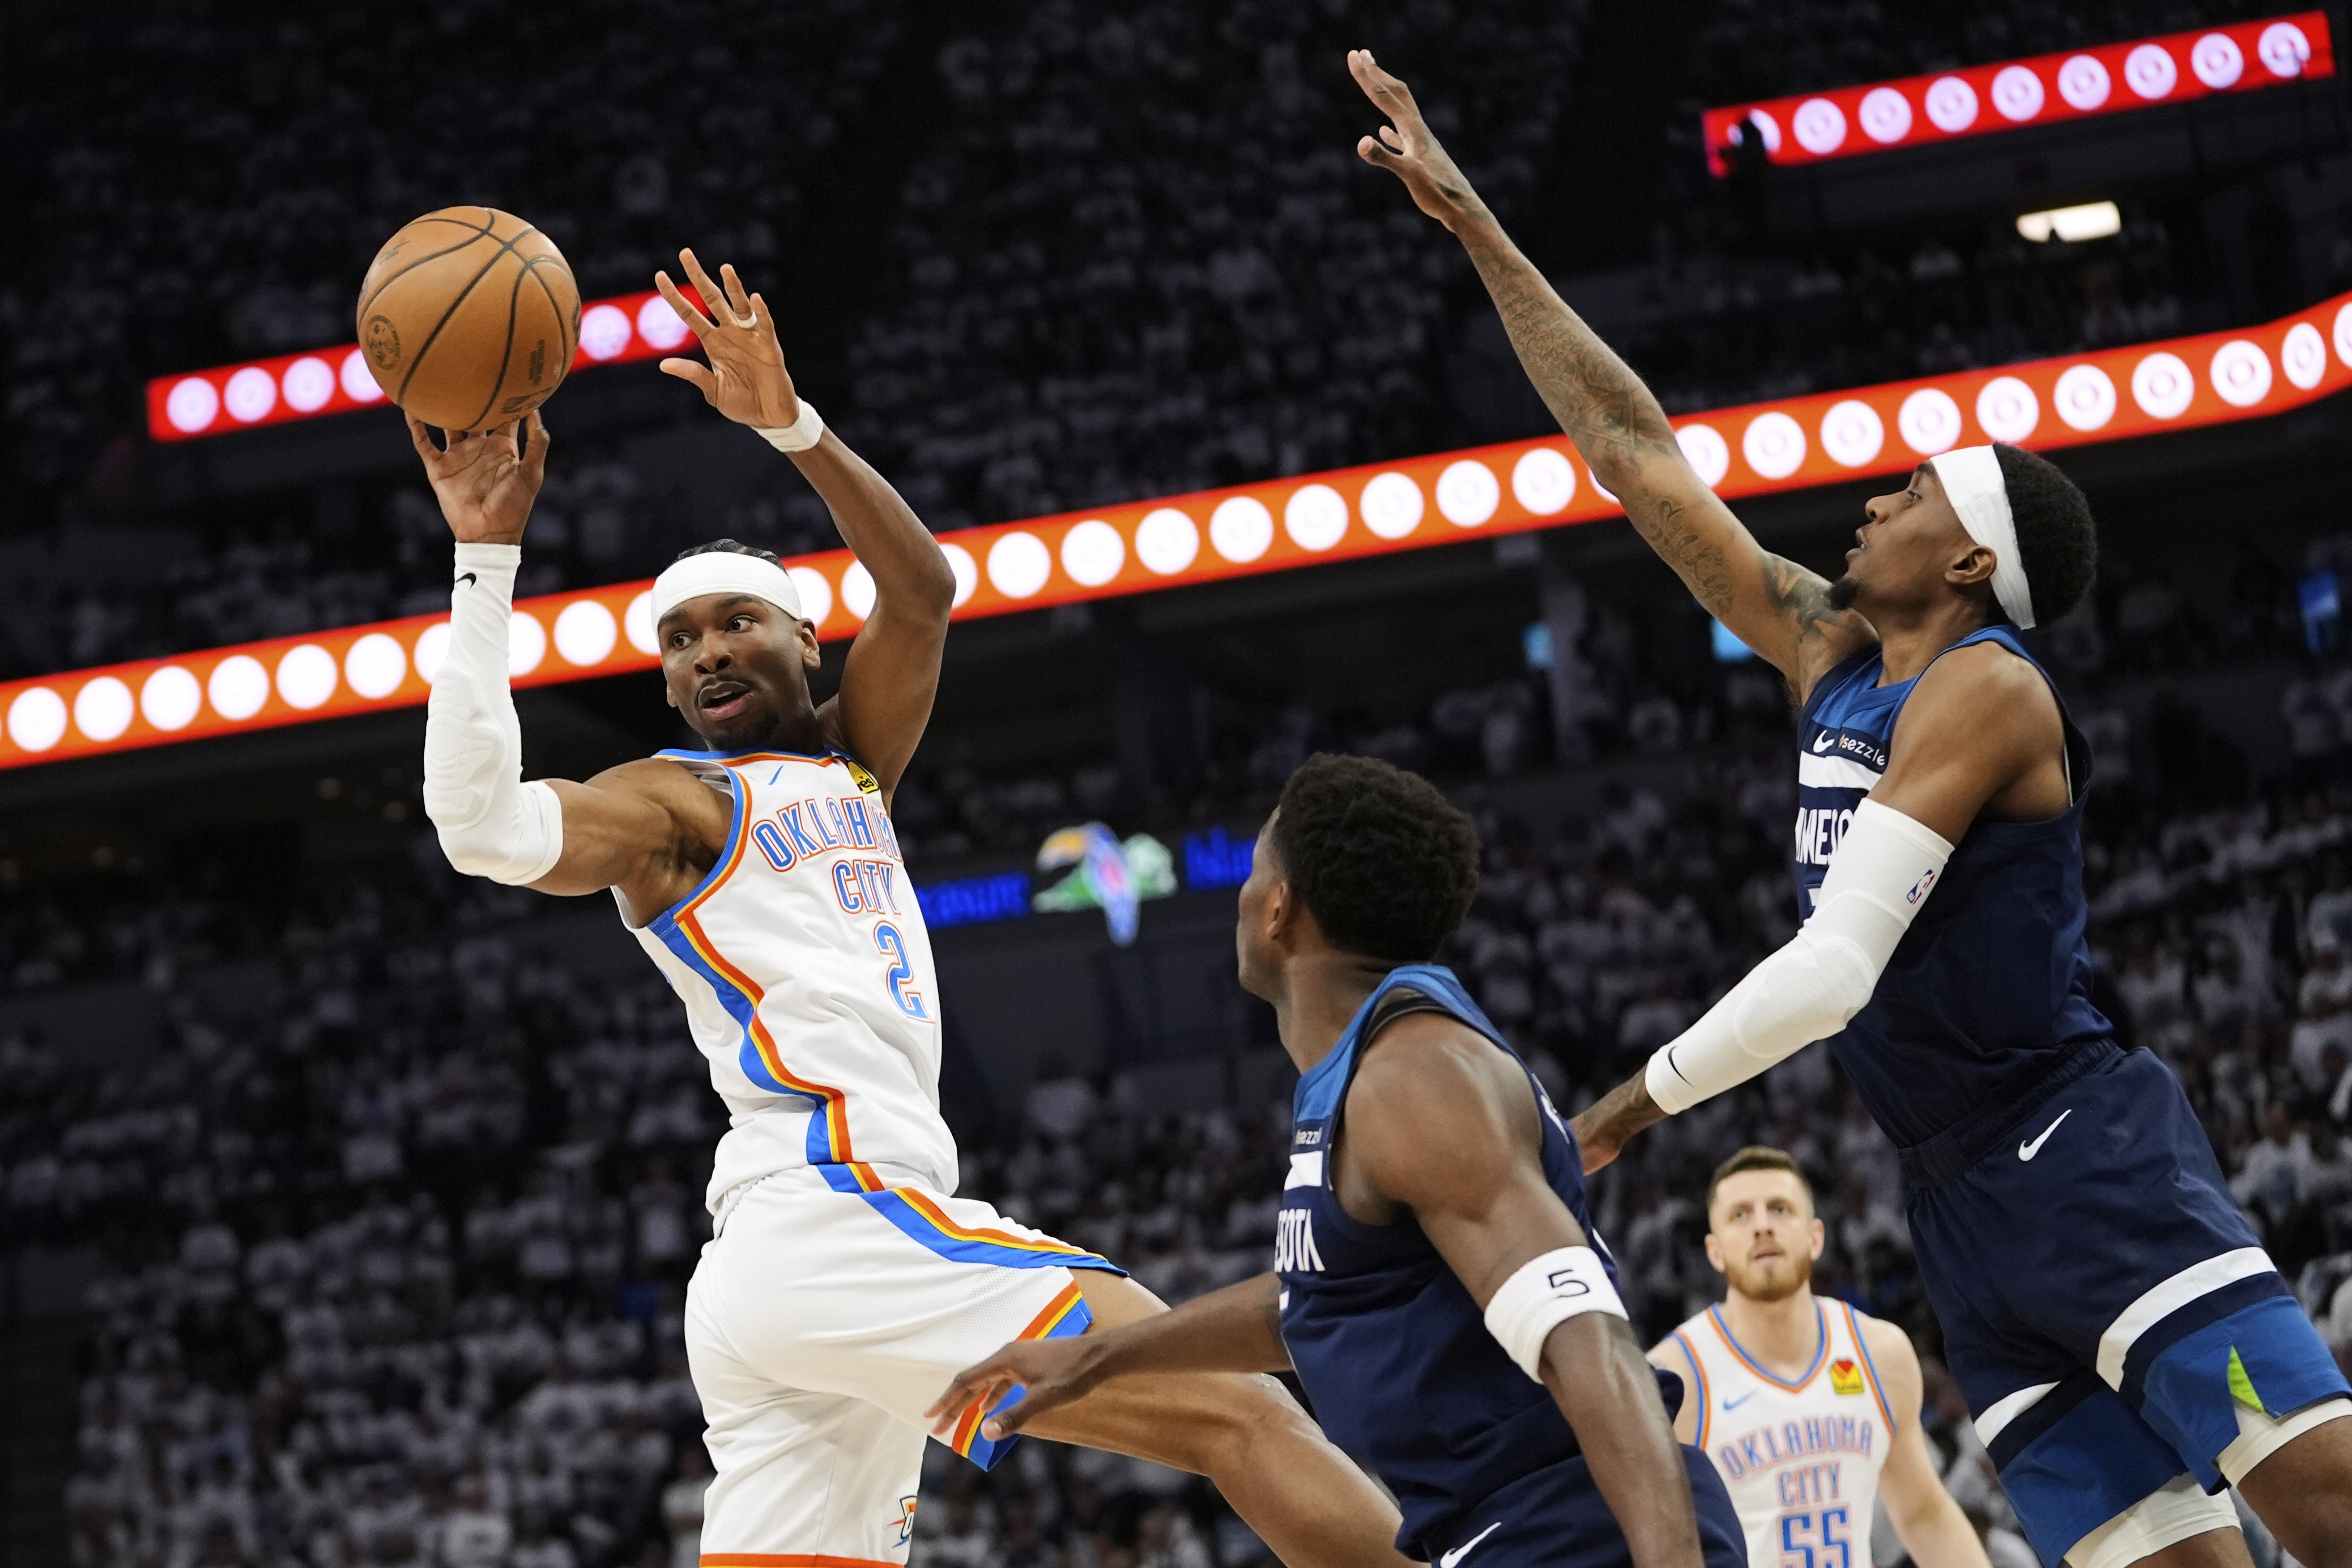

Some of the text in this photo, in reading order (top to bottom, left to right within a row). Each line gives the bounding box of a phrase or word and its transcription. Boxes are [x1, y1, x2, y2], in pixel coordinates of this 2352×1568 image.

[1841, 736, 1885, 766] sezzle
[832, 858, 901, 914] CITY
[873, 920, 936, 1024] 2
[1548, 1269, 1590, 1298] 5
[1718, 1414, 1873, 1481] OKLAHOMA
[1776, 1459, 1841, 1507] CITY
[1778, 1505, 1854, 1568] 55
